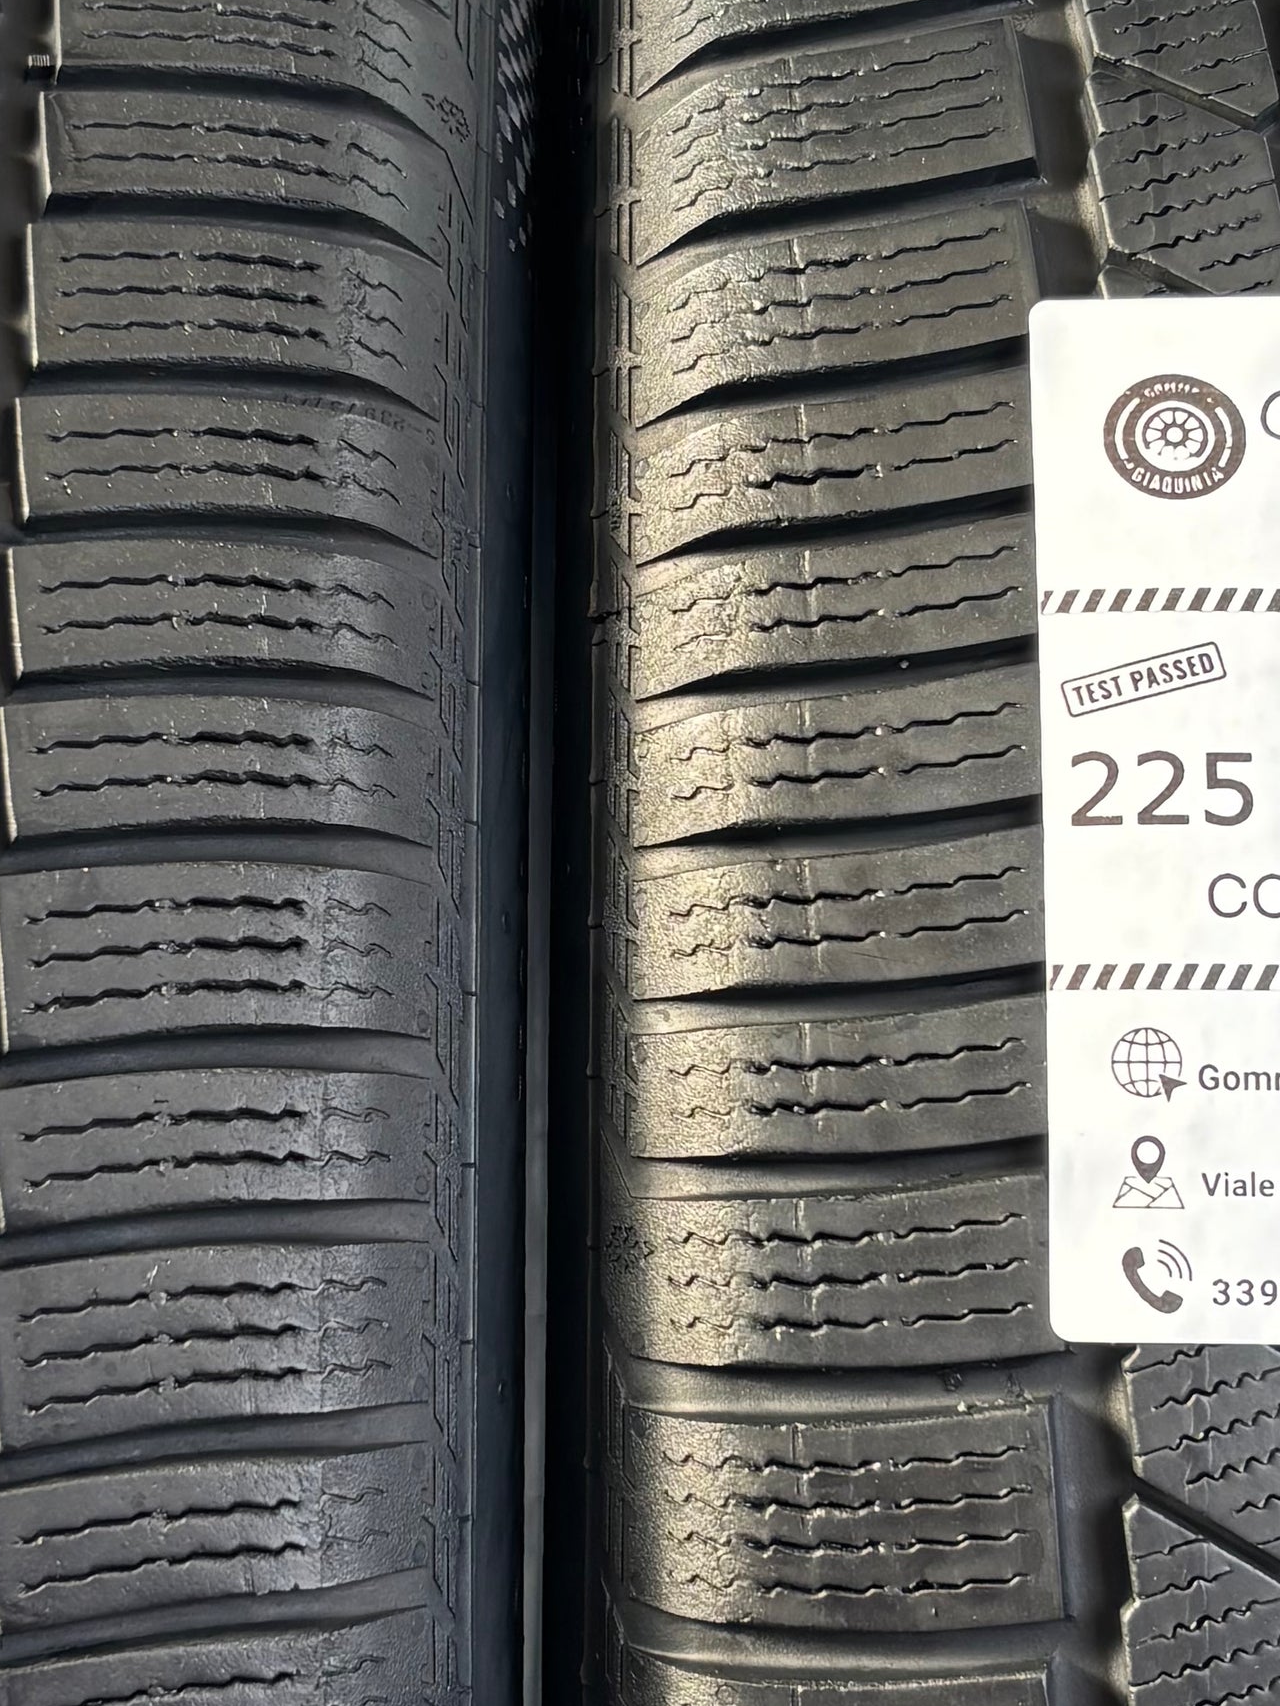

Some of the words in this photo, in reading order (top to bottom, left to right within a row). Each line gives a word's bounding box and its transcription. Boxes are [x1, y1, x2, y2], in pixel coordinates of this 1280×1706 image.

[1072, 675, 1123, 706] TEST
[1129, 653, 1214, 692] PASSED
[1071, 750, 1254, 827] 225
[1201, 1171, 1275, 1197] Viale
